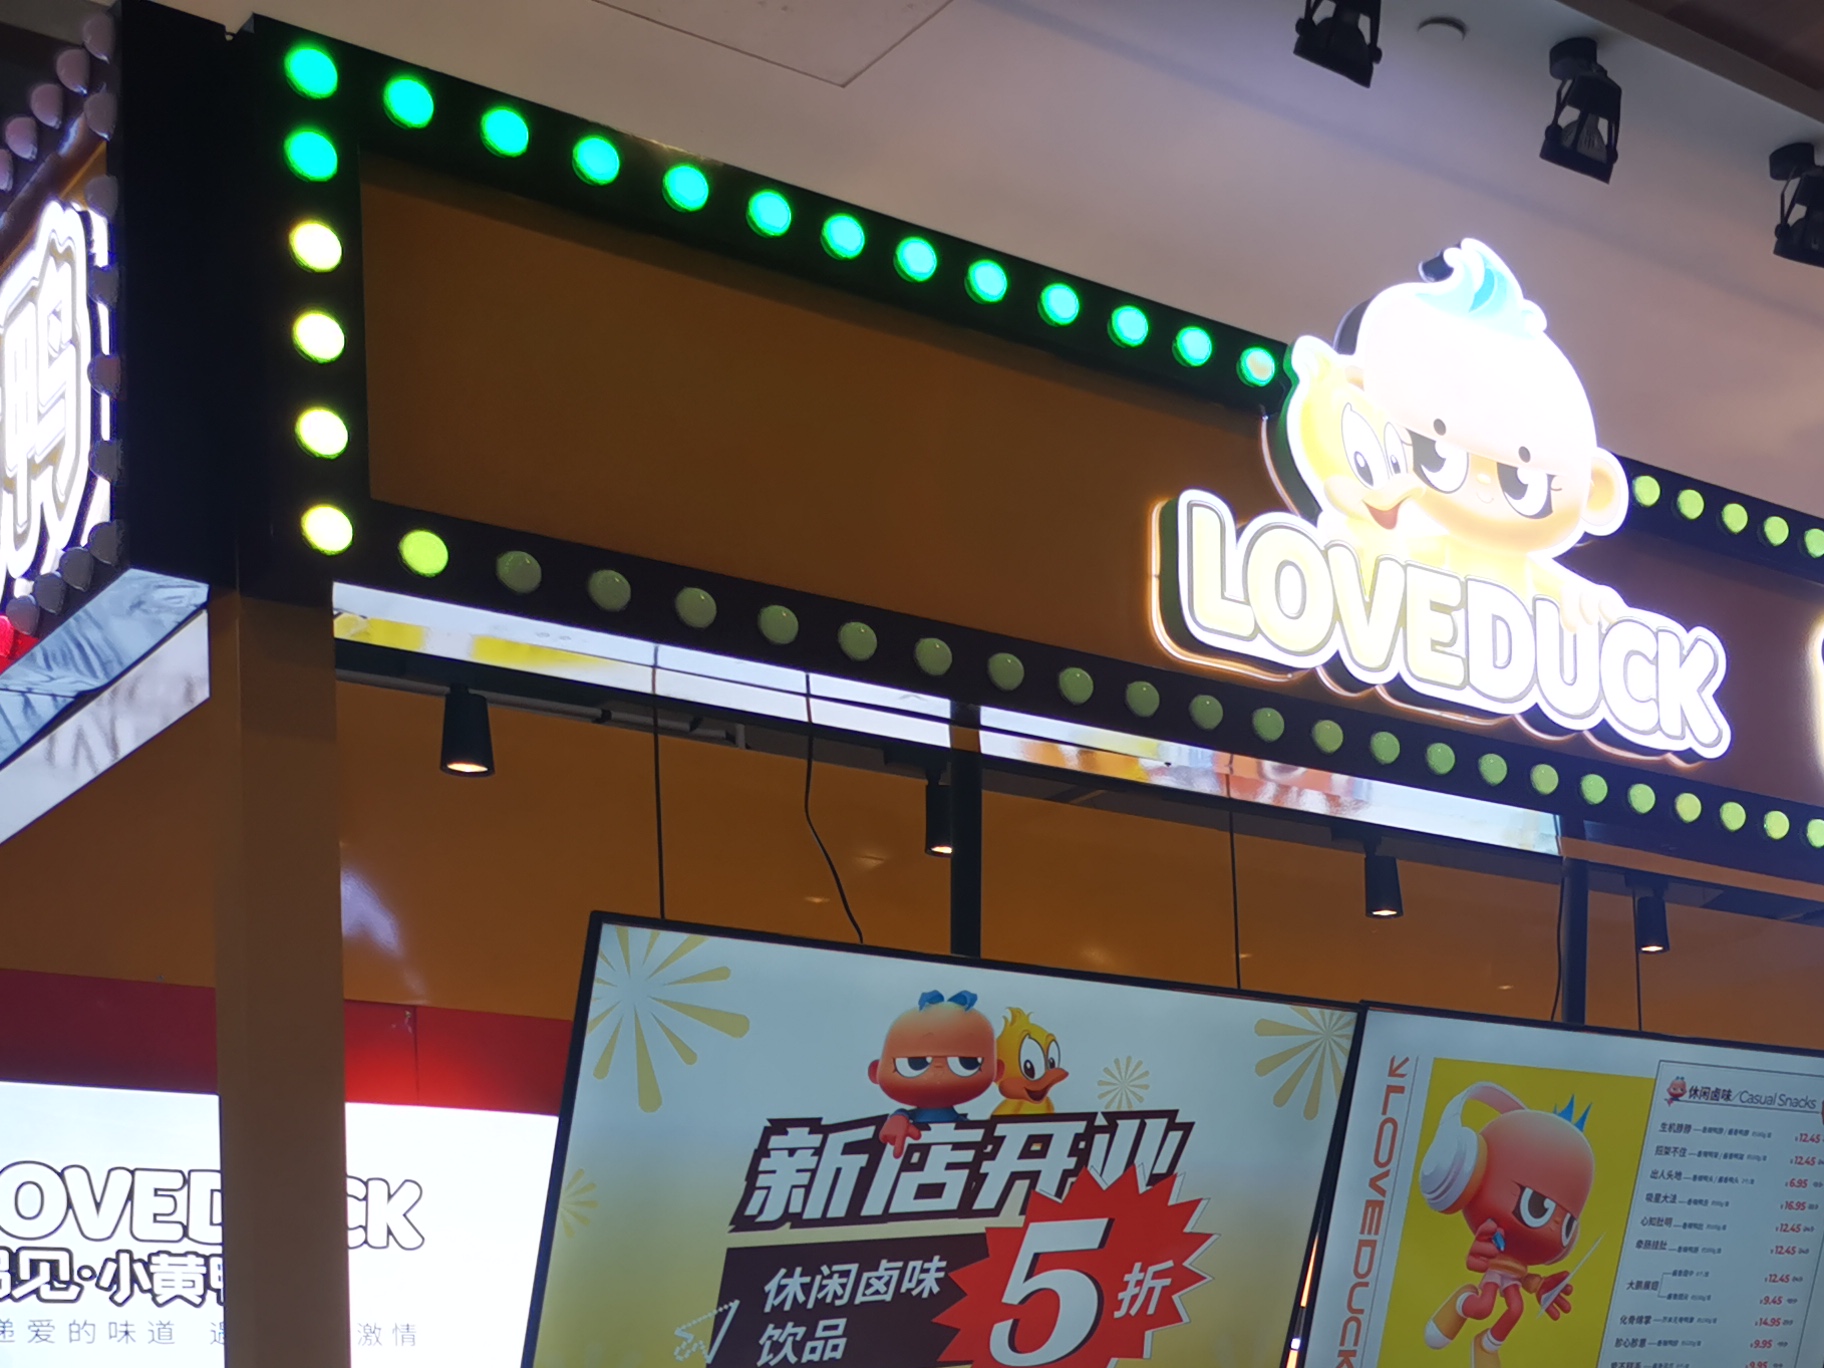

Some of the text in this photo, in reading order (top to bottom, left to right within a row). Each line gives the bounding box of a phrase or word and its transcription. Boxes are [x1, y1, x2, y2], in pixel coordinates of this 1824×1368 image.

[1185, 500, 1726, 748] LOVEDUCK
[1777, 1093, 1817, 1110] Snacks
[743, 1116, 1186, 1223] 新店开业
[1648, 1168, 1682, 1181] 出人头地
[0, 1246, 222, 1307] 见·小黄
[763, 1255, 947, 1313] 休闲卤味
[757, 1317, 848, 1368] 饮品
